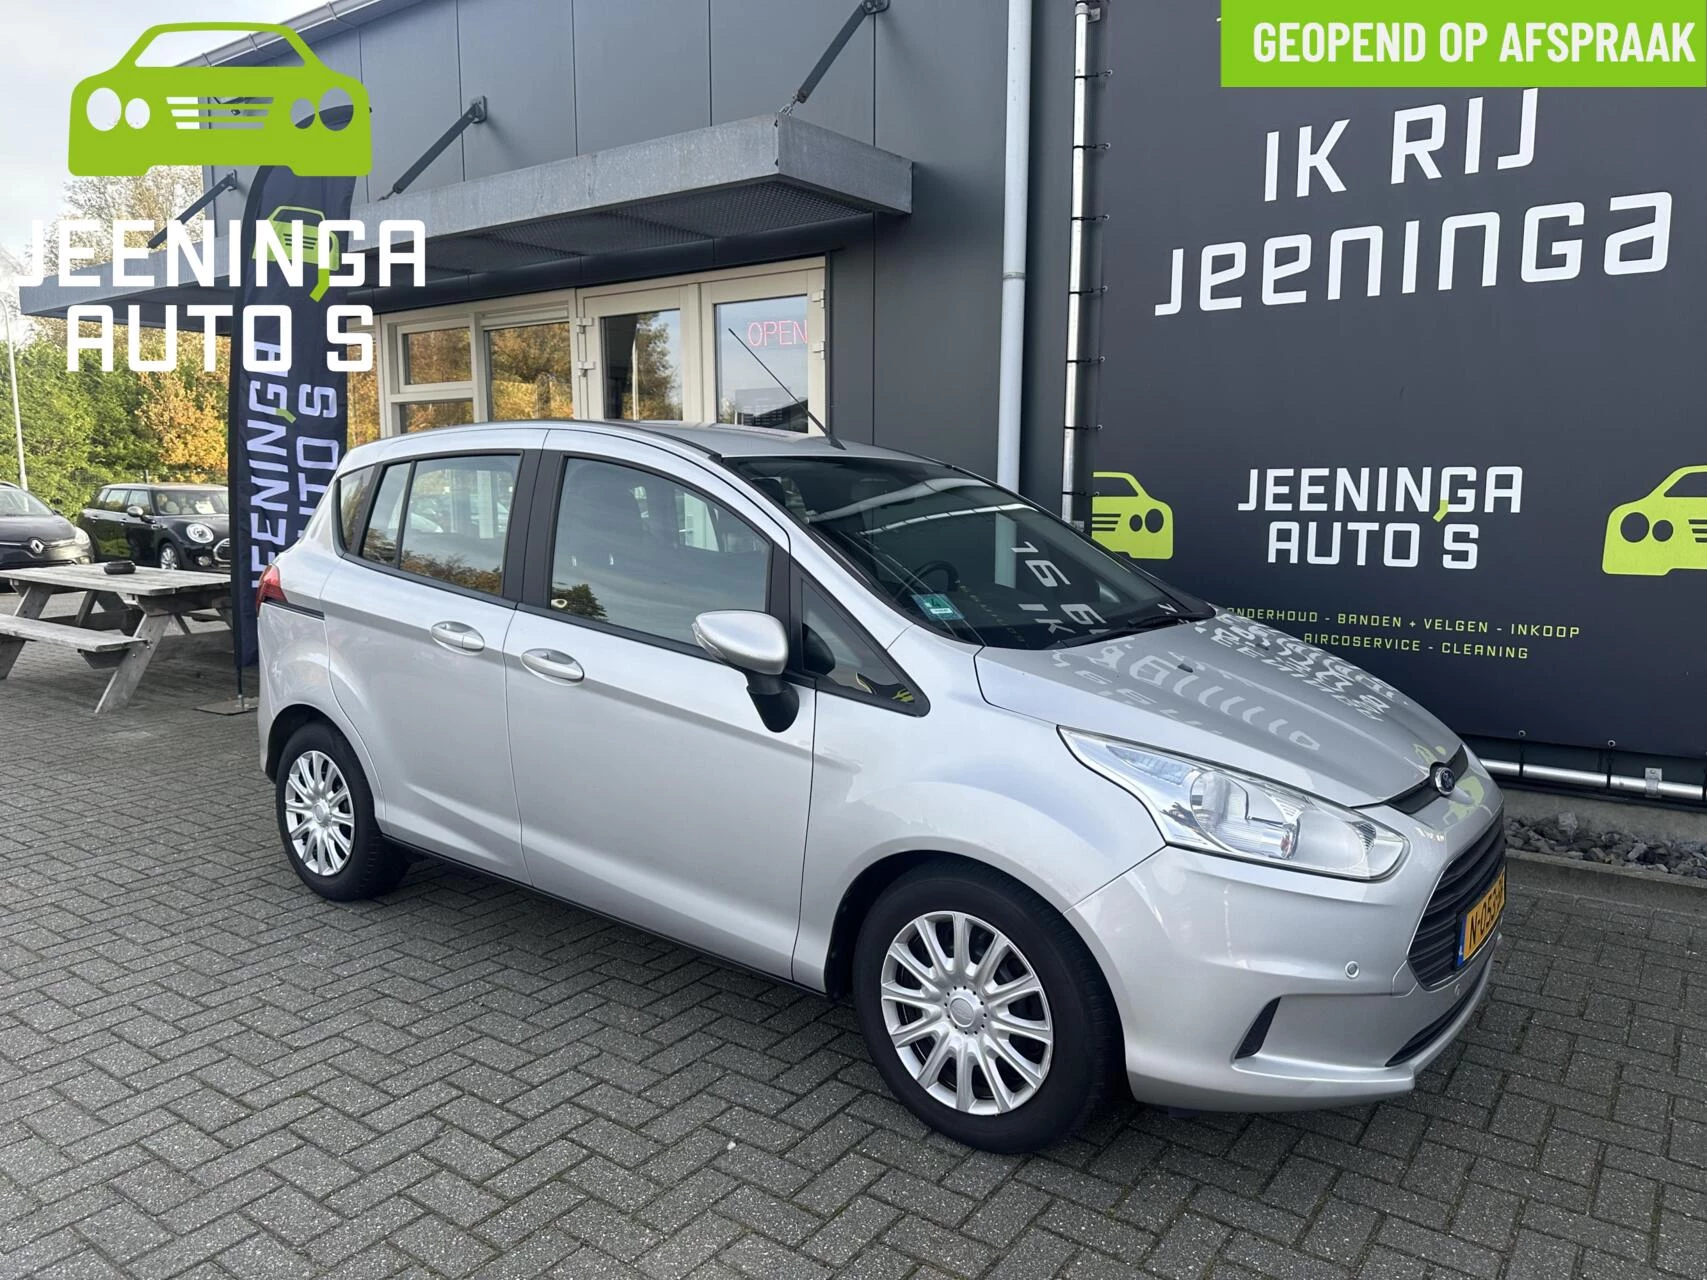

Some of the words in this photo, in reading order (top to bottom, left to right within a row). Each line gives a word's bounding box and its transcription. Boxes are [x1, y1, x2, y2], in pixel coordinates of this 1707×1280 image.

[1264, 119, 1350, 202] IK
[1390, 88, 1539, 185] RIJ
[747, 319, 808, 347] OPEN
[1237, 466, 1523, 513] JEENINGA
[1337, 613, 1402, 628] BANDEN
[1423, 618, 1489, 634] VELGEN
[1510, 623, 1580, 639] INKOOP
[1303, 632, 1421, 652] AIRCOSERVICE
[1441, 641, 1529, 660] CLEANING
